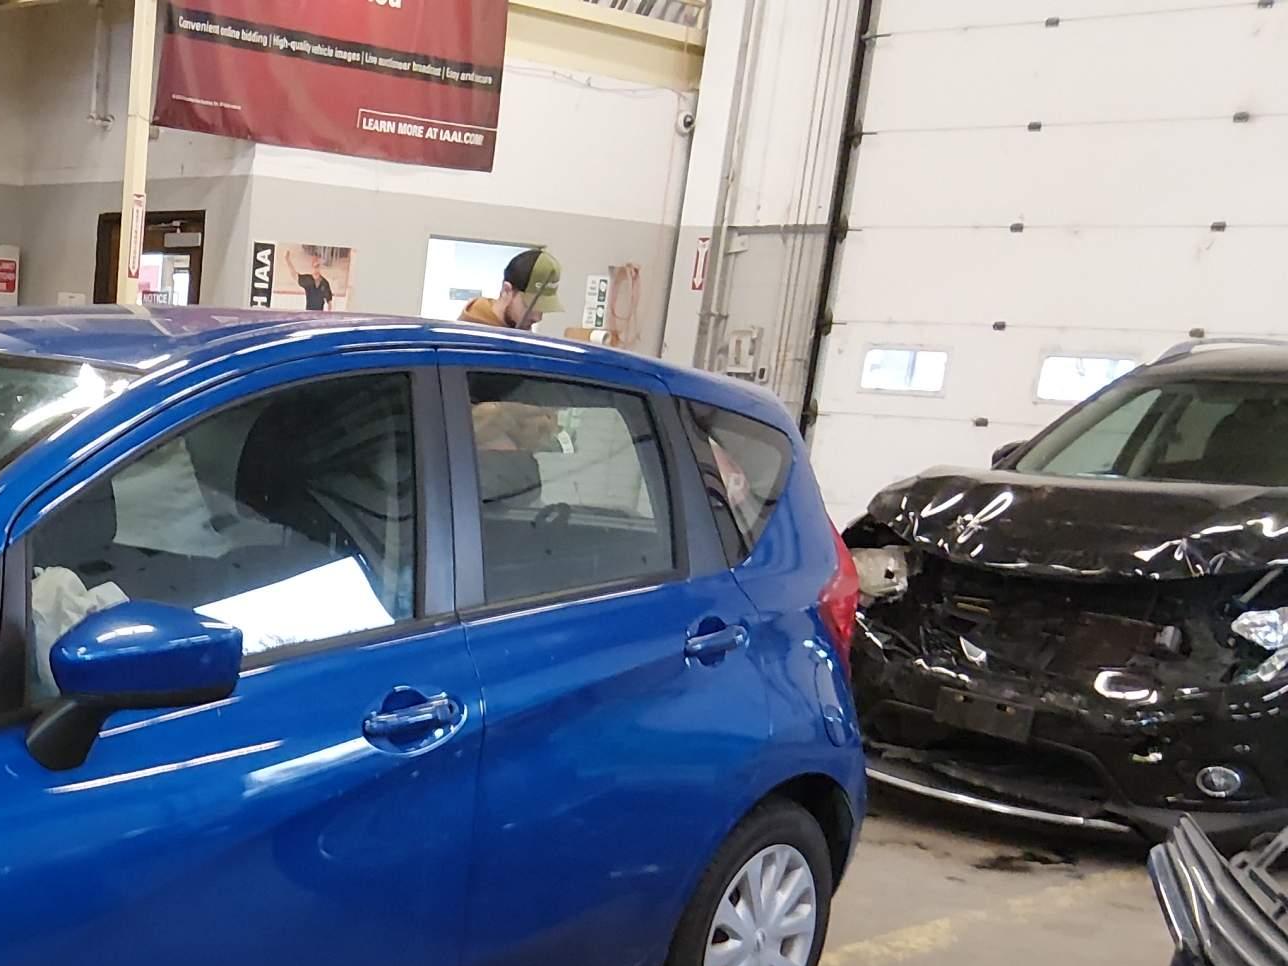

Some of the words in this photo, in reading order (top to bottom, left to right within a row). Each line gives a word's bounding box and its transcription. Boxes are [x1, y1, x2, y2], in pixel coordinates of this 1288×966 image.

[178, 15, 220, 35] Convenient
[241, 28, 268, 47] bidding
[334, 46, 361, 63] images
[362, 116, 396, 134] LEARN
[397, 121, 425, 138] MORE
[425, 127, 440, 140] AT
[439, 128, 485, 146] IAAI.COM
[254, 248, 272, 289] IAA
[142, 293, 169, 305] NOTICE
